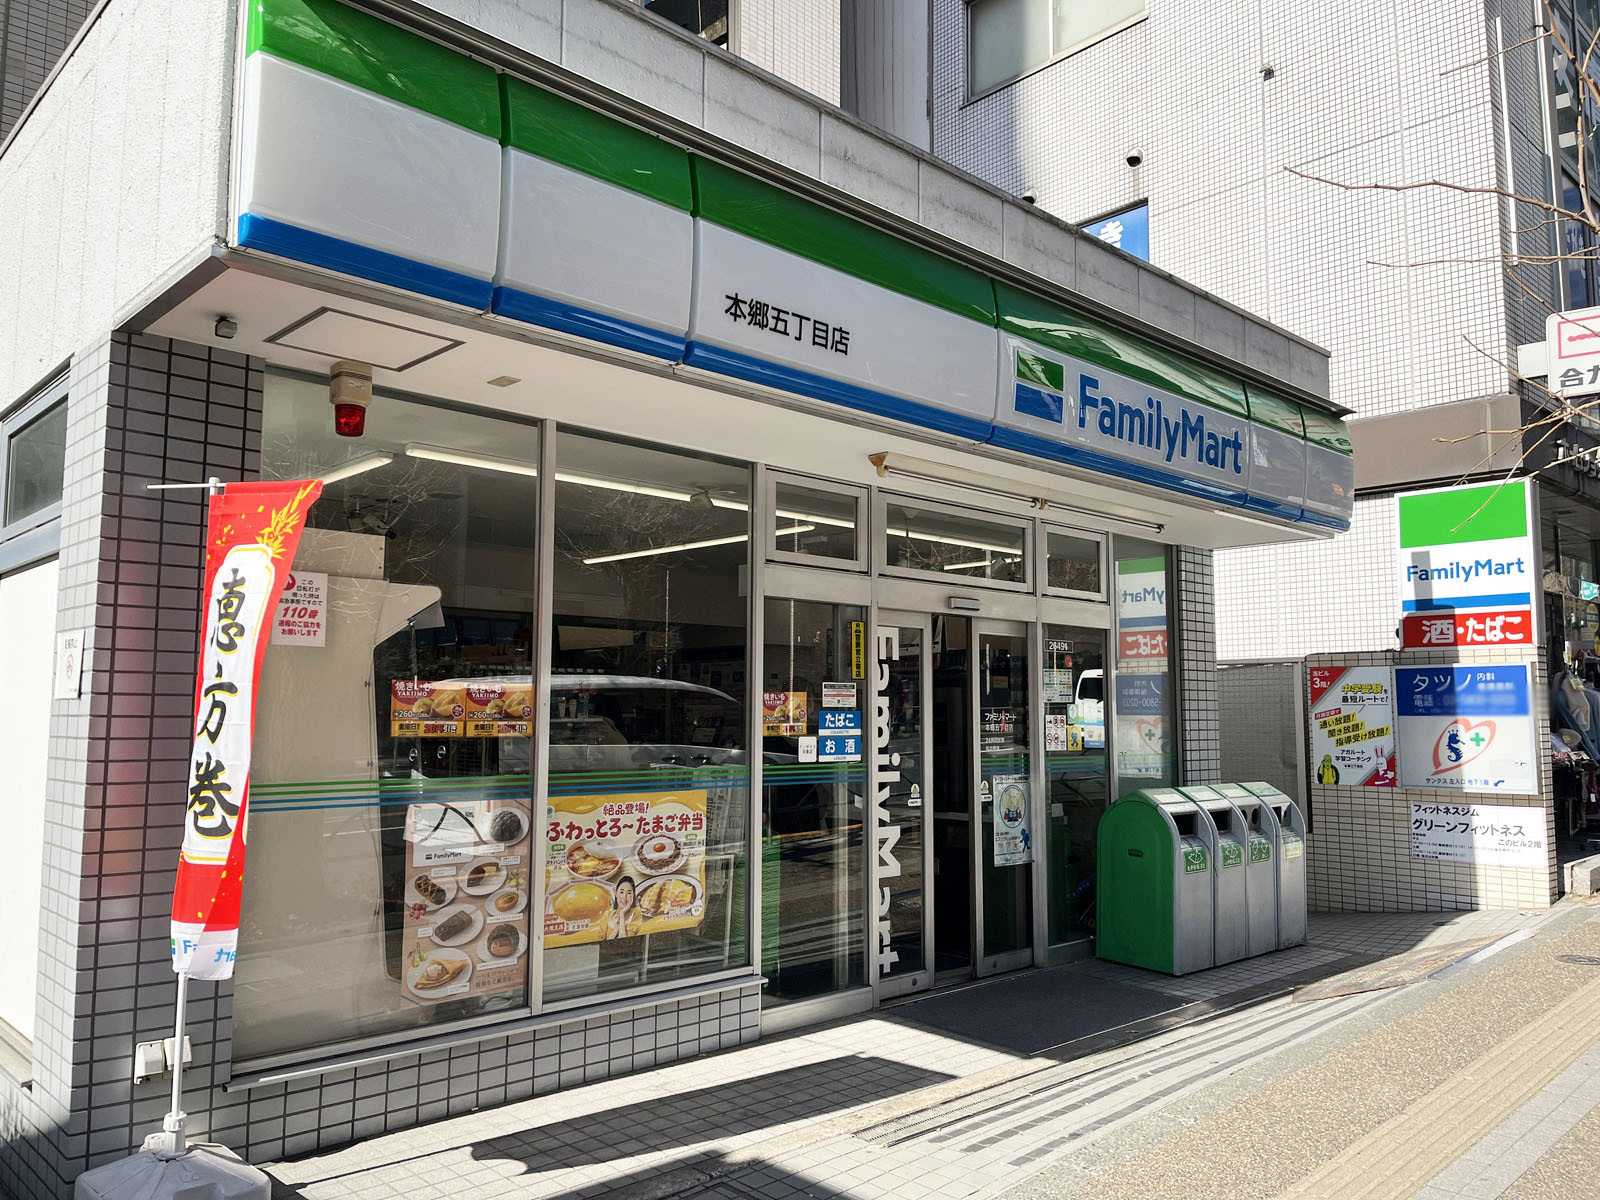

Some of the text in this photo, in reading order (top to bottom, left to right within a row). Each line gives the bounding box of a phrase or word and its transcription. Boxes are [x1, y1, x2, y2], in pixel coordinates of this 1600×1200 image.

[724, 293, 850, 356] 本郷五丁目店
[1078, 373, 1243, 475] FamilyMart
[1406, 557, 1525, 583] FamilyMart
[282, 606, 319, 619] 110番
[281, 628, 318, 637] お願いします
[1421, 614, 1525, 645] 酒・たばこ
[187, 567, 246, 840] 恵方巻
[825, 713, 855, 728] たばこ
[602, 802, 650, 816] 絶品登場!
[877, 626, 901, 974] FamilyMart
[1413, 804, 1480, 817] フィットネスジム
[1412, 818, 1526, 837] グリーンフィットネス
